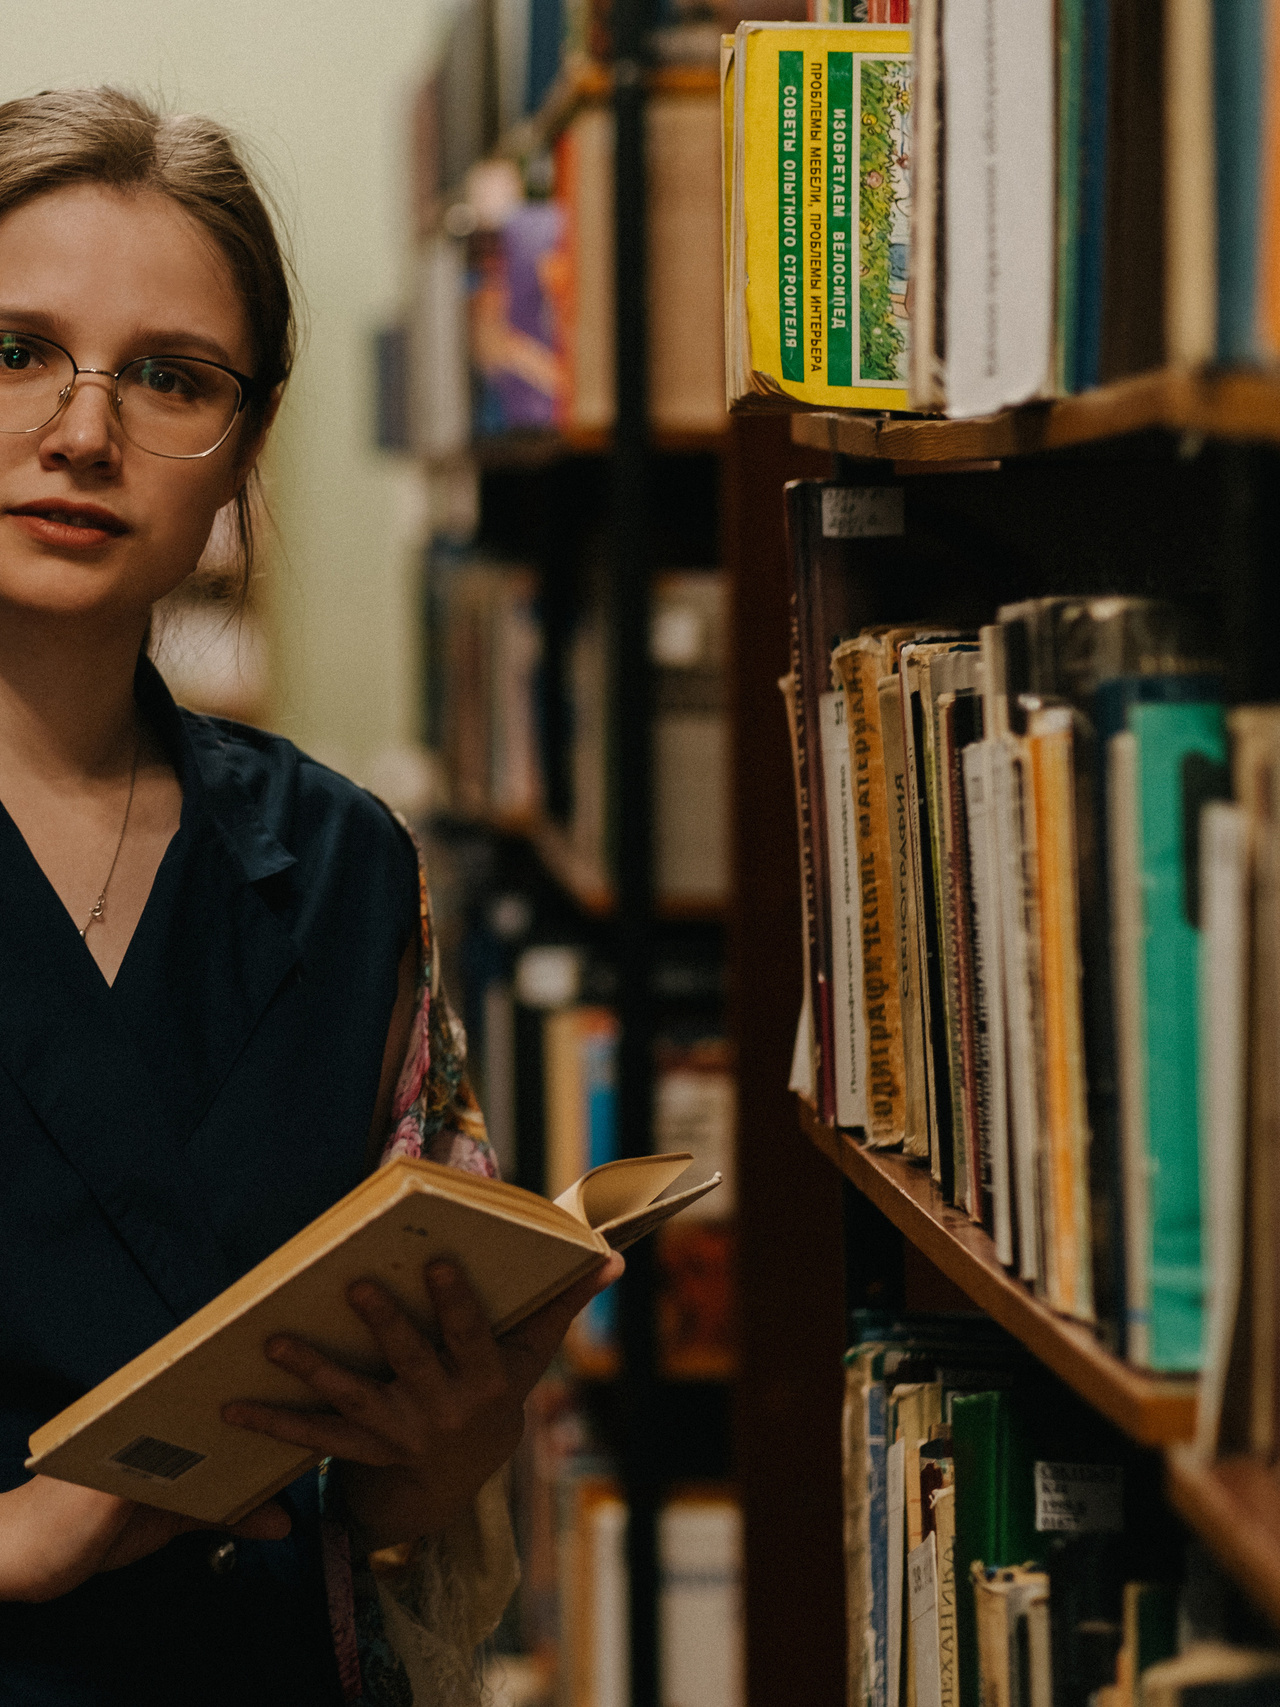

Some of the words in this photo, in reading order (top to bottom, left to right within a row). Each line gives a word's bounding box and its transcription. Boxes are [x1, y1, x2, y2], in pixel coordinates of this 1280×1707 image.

[783, 85, 797, 152] СОВЕТЫ
[810, 62, 823, 141] ПРОБЛЕМЫ
[783, 159, 797, 247] ОПЫТНОГО
[809, 147, 823, 207] МЕБЕЛИ,
[832, 108, 846, 218] ИЗОБРЕТАЕМ
[809, 213, 822, 290] ПРОБЛЕМЫ
[831, 231, 848, 330] ВЕЛОСИПЕД
[783, 254, 797, 348] СТРОИТЕЛЯ
[810, 296, 822, 372] ИНТЕРЬЕРА
[895, 773, 909, 998] СТЕНОГРАФИЯ
